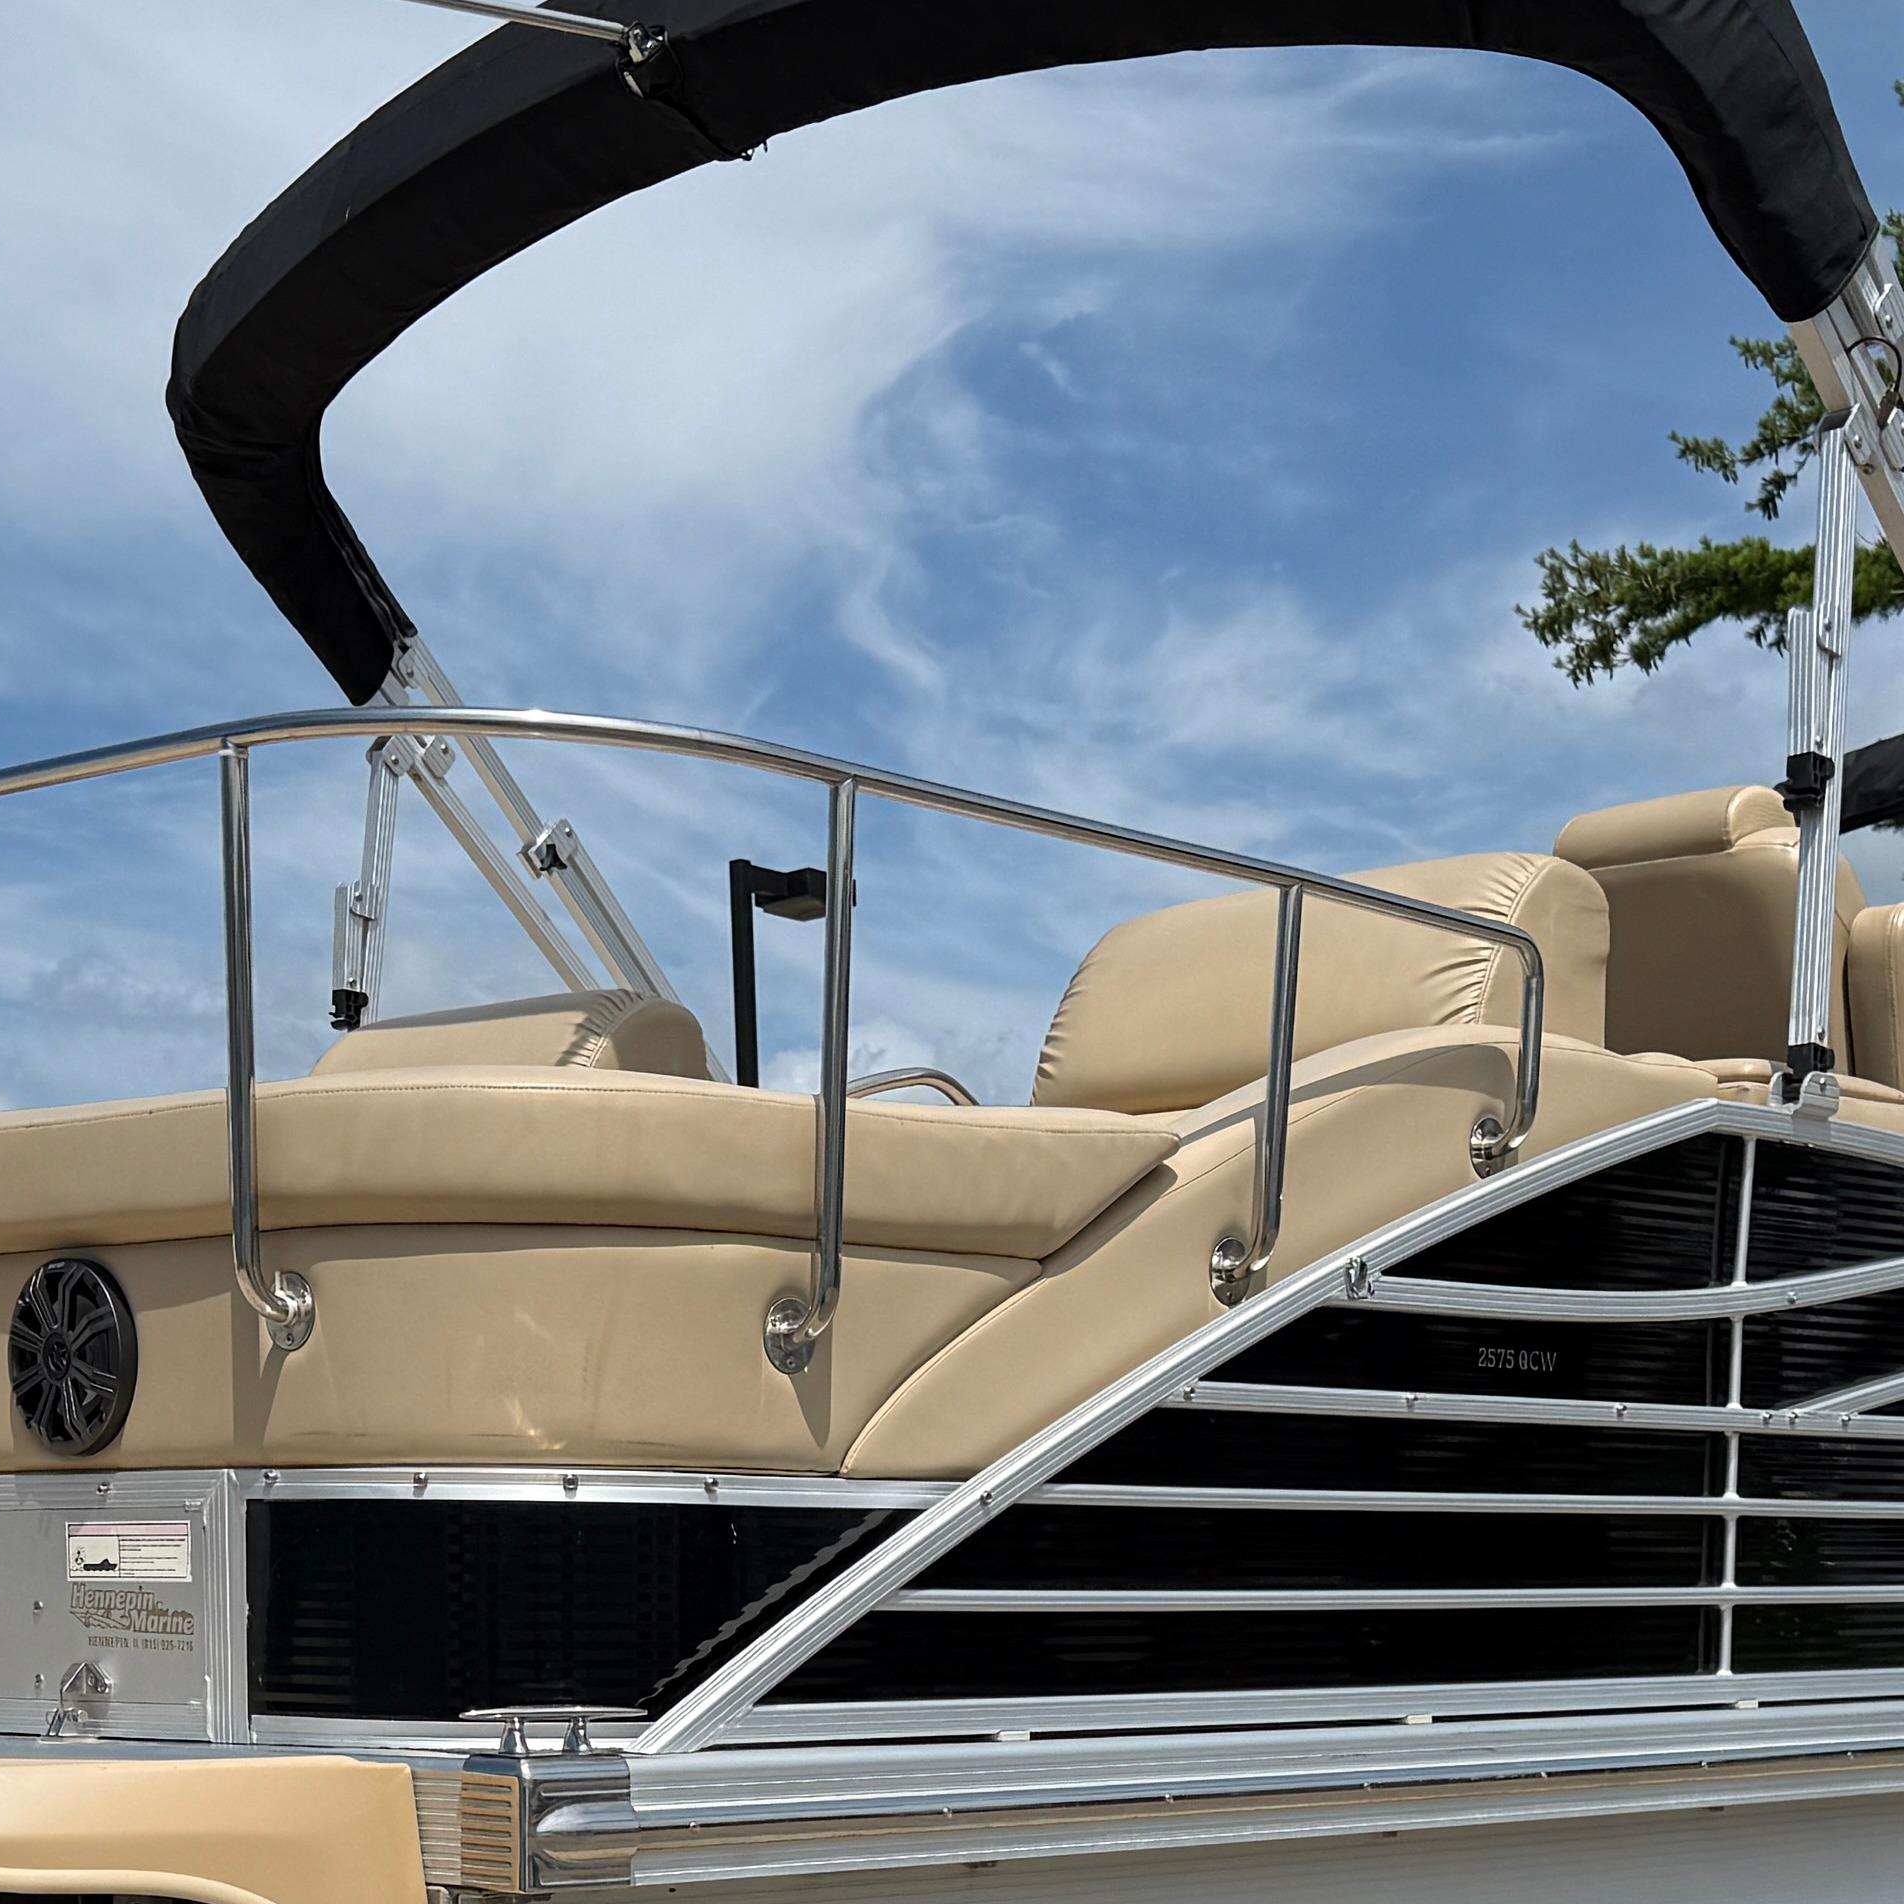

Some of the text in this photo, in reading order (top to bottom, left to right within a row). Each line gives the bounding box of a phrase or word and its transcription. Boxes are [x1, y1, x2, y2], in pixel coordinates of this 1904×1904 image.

[1478, 1347, 1557, 1372] 2575 QCW
[71, 1582, 155, 1614] Hennepin
[130, 1608, 195, 1635] Marine
